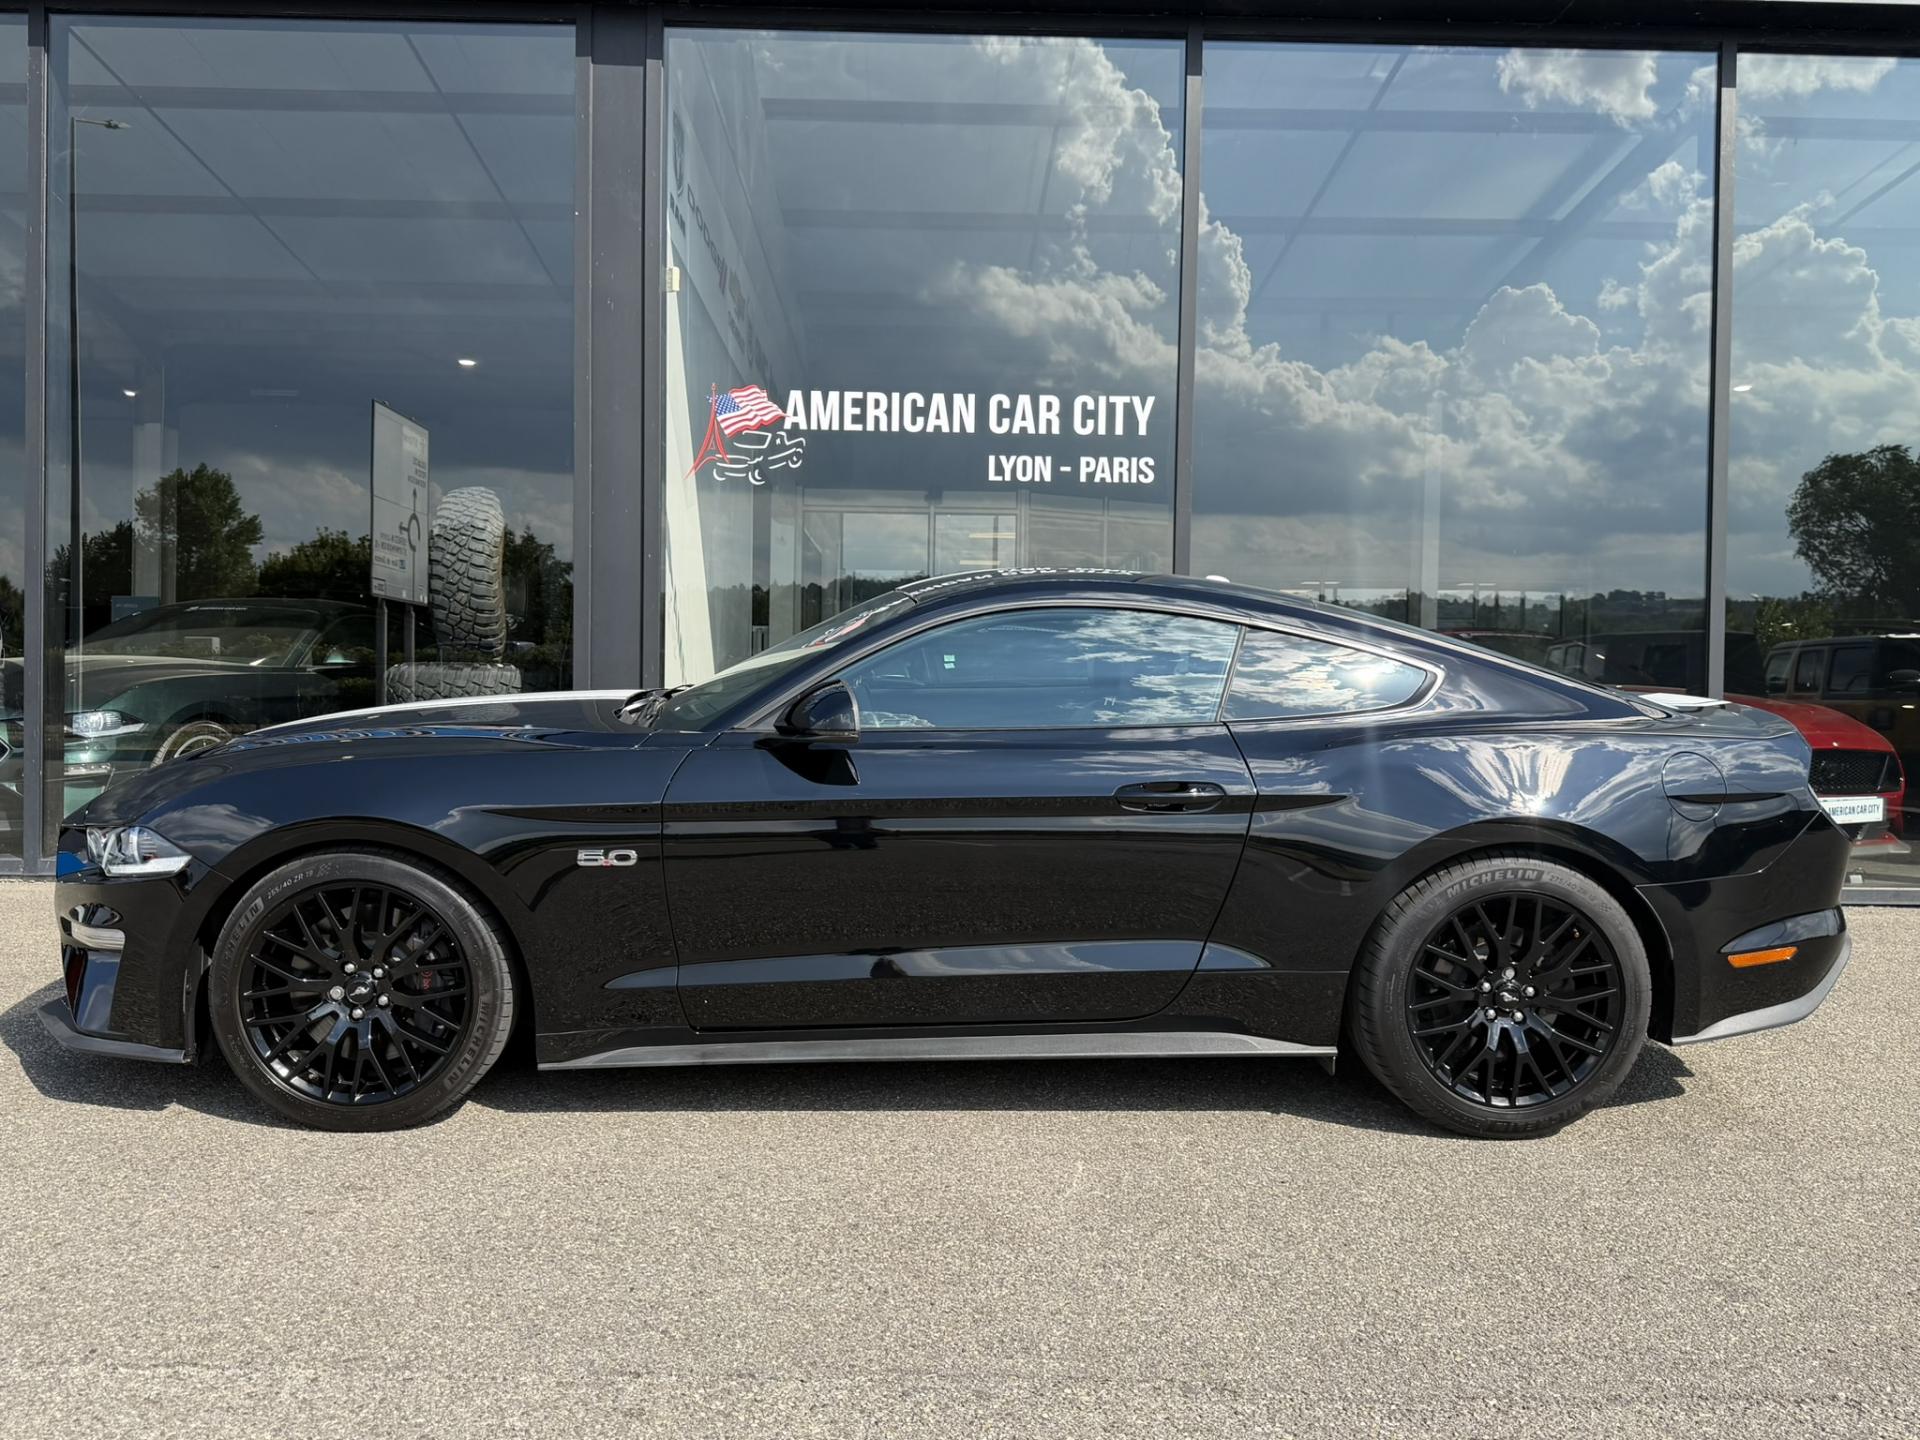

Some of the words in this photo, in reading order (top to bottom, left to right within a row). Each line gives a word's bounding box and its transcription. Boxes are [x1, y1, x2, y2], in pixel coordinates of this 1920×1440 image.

[784, 390, 976, 433] AMERICAN
[989, 394, 1060, 435] CAR
[1073, 395, 1155, 436] CITY
[988, 455, 1051, 482] LYON
[1079, 457, 1155, 483] PARIS
[1828, 805, 1855, 816] AMERICAN
[1856, 804, 1867, 815] CAR
[1868, 804, 1880, 814] CITY
[577, 849, 638, 867] 5.0
[1446, 869, 1539, 898] MICHELIN
[450, 1001, 491, 1085] MICHELIN
